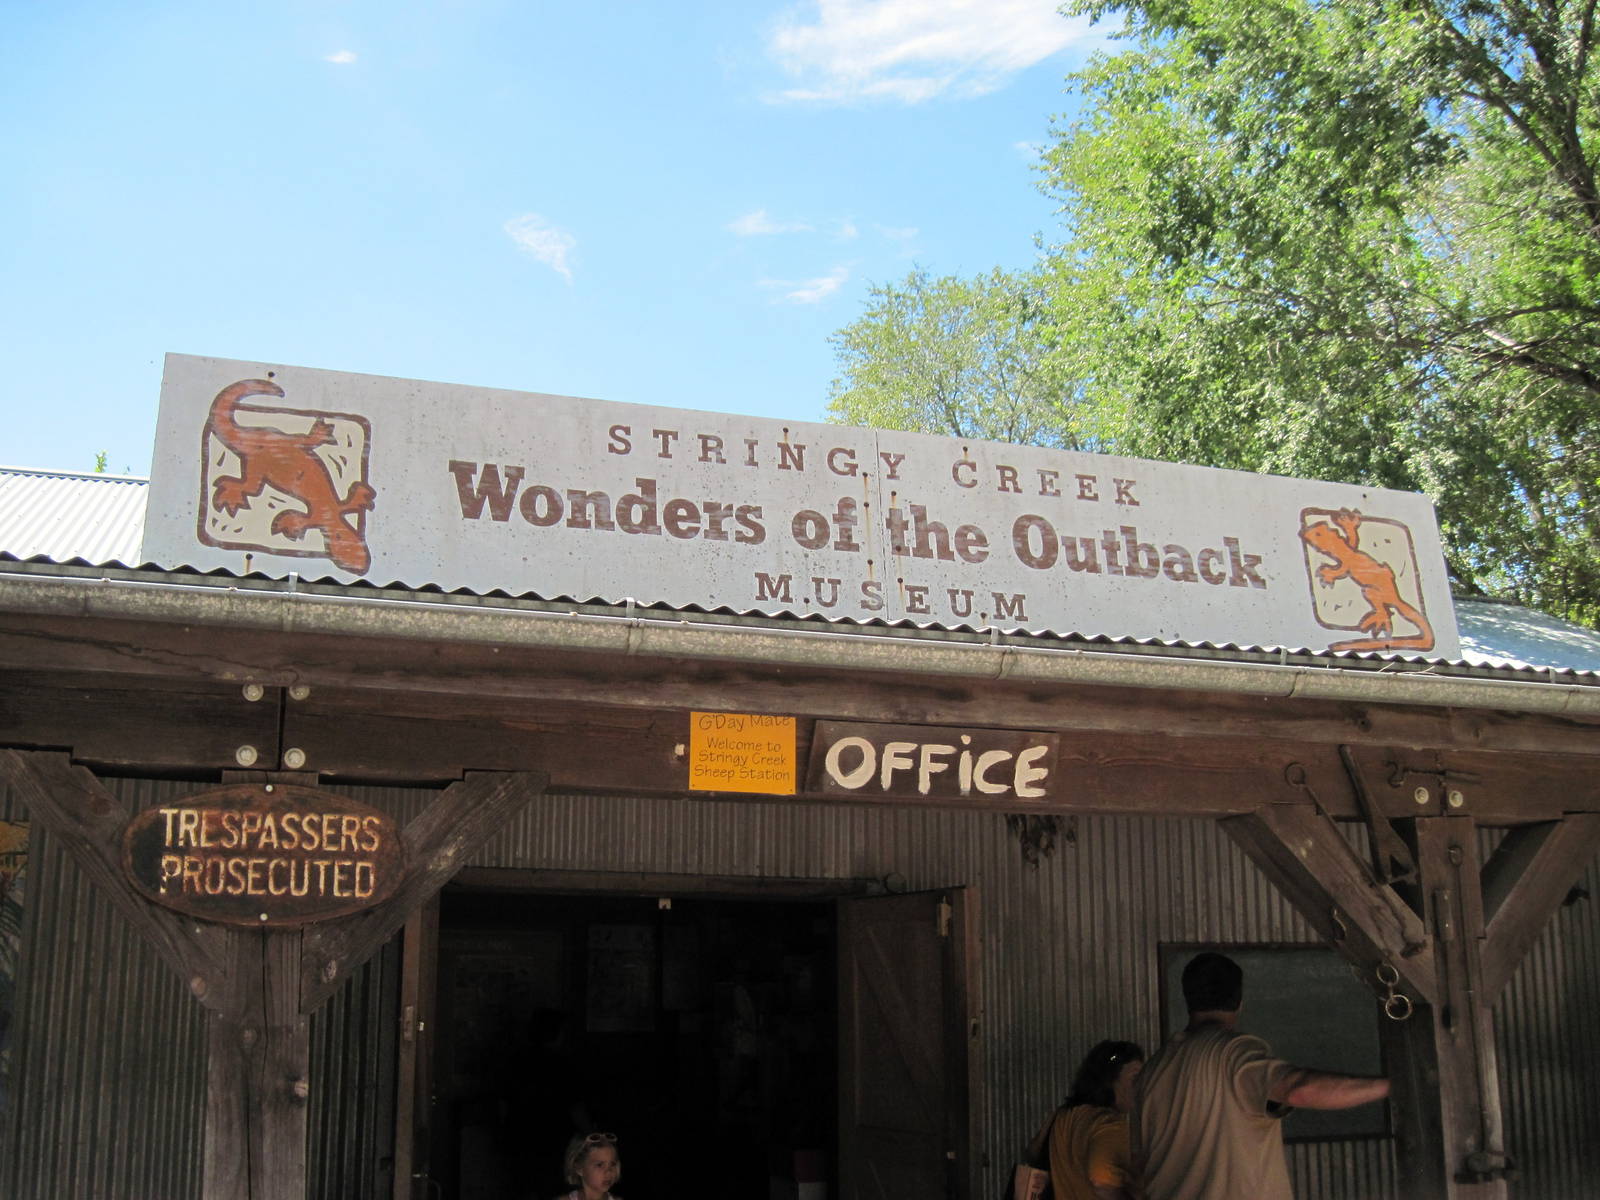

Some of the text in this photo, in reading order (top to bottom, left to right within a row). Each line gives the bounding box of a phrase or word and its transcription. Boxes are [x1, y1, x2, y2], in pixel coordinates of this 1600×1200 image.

[608, 424, 1140, 507] STRINGY CREEK
[449, 459, 1267, 590] Wonders of the Outback
[754, 572, 1029, 622] MUSEUM
[750, 715, 790, 728] Mate
[699, 750, 786, 766] Stringy Creek
[707, 738, 781, 752] Welcome to
[695, 764, 790, 782] Sheep Station
[159, 808, 381, 852] TRESPASSERS
[160, 855, 376, 898] PROSECUTED
